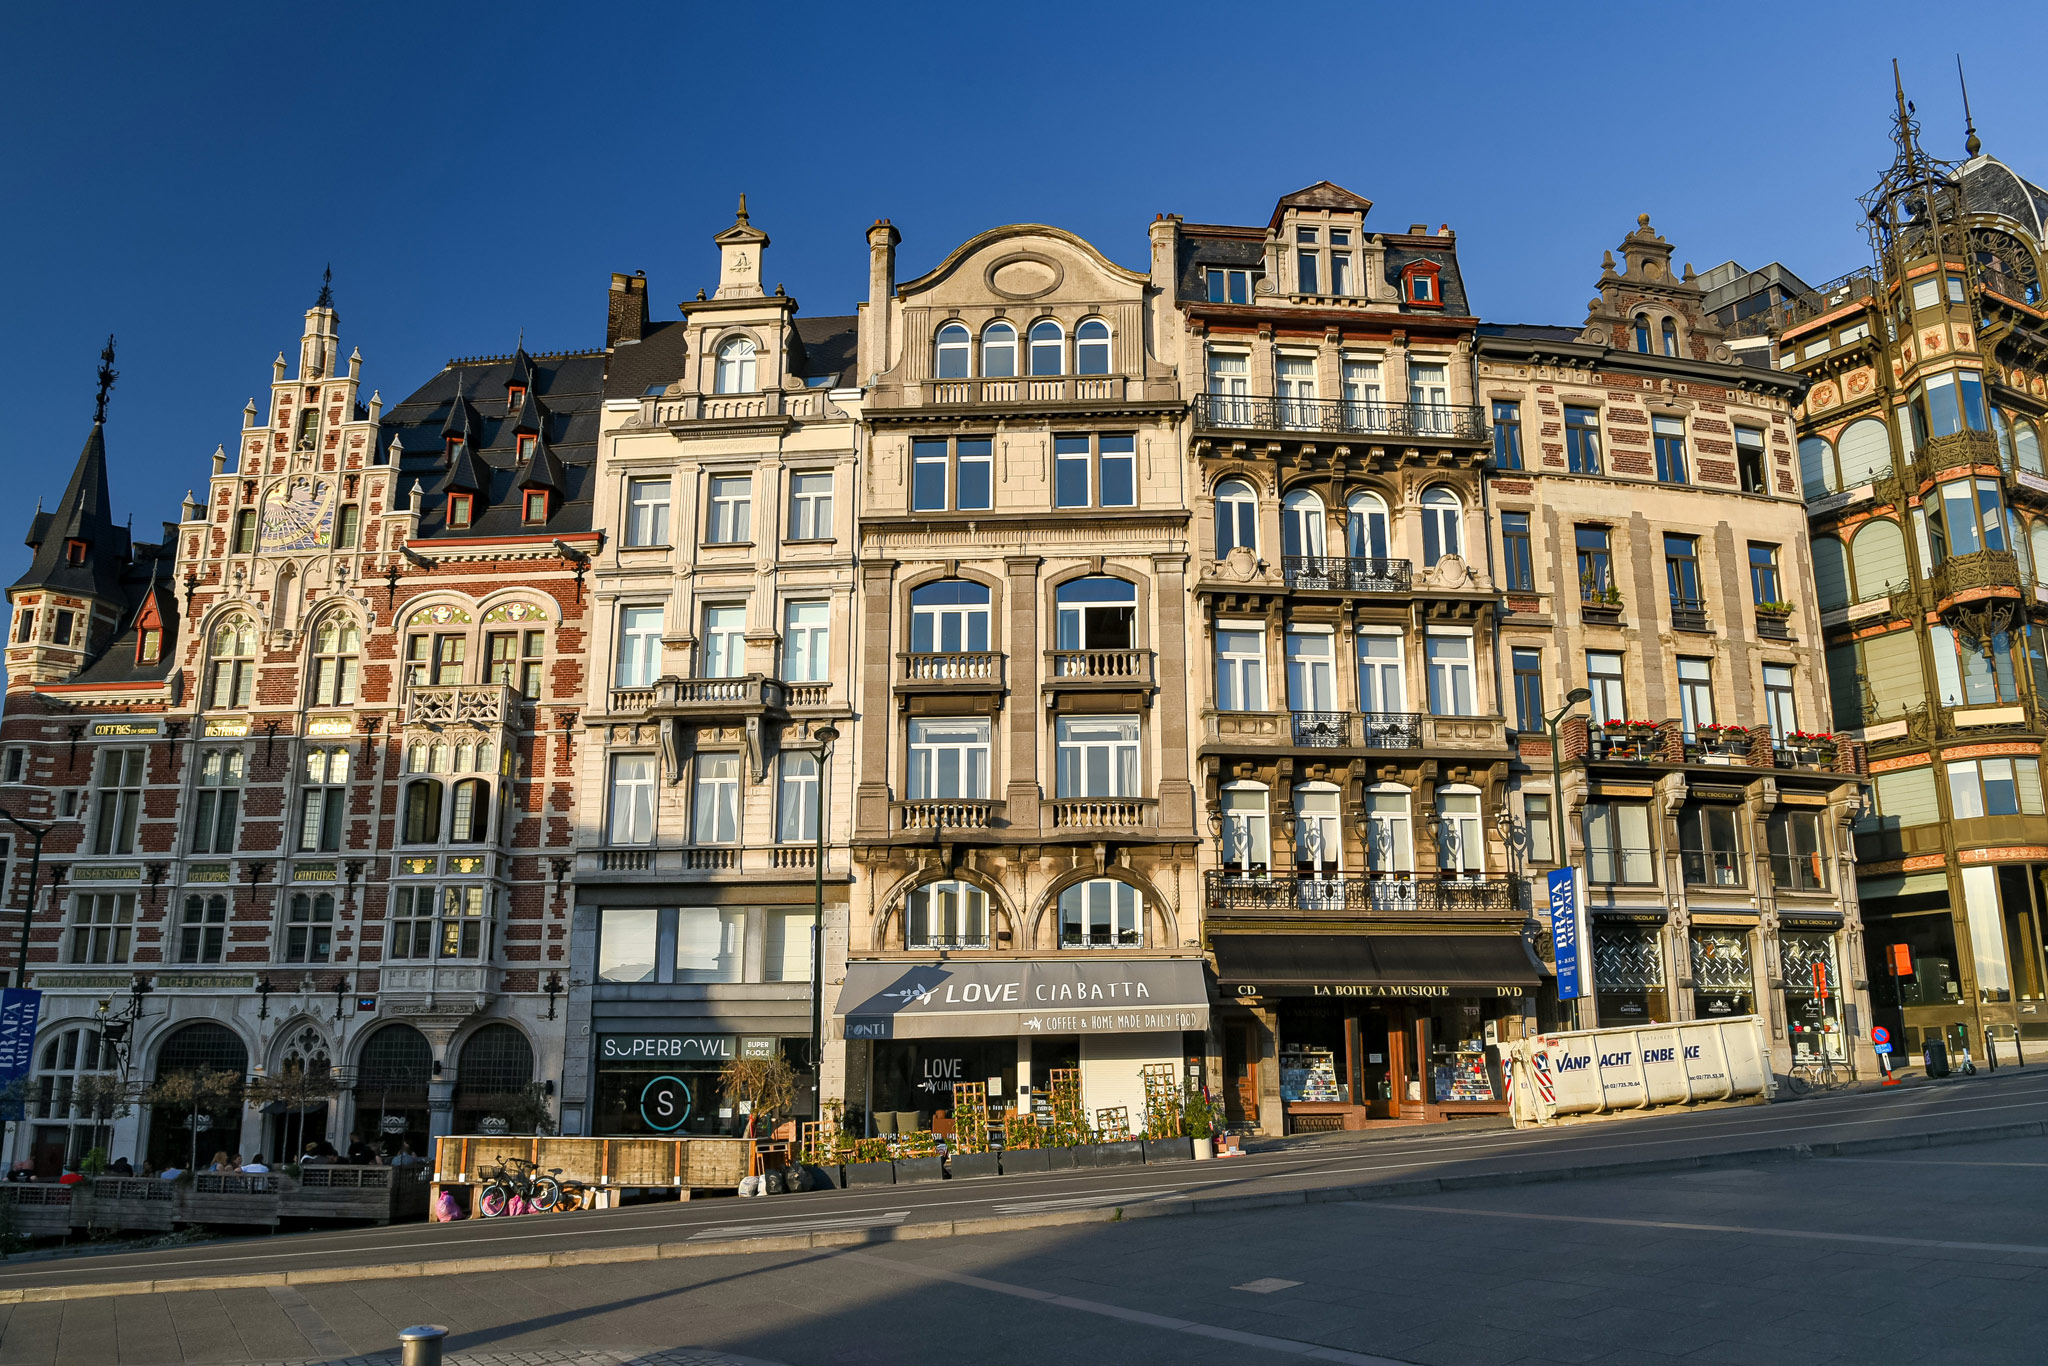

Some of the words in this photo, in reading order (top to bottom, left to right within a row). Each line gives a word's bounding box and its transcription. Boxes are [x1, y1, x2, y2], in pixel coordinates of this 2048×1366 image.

[1563, 879, 1573, 914] FAIR
[1551, 879, 1567, 949] BRAFA
[1566, 916, 1575, 946] ART
[945, 982, 1020, 1004] LOVE
[1035, 981, 1150, 1002] CIABATTA
[1237, 985, 1256, 995] CD
[1313, 985, 1331, 996] LA
[1335, 985, 1373, 996] BOITE
[1377, 986, 1387, 996] A
[1390, 985, 1450, 997] MUSIQUE
[1496, 986, 1523, 997] DVD
[19, 1003, 36, 1037] FAIR
[1046, 1017, 1078, 1031] COFFEE
[1081, 1020, 1087, 1029] &
[1091, 1016, 1113, 1030] HOME
[1117, 1015, 1141, 1029] MADE
[1145, 1014, 1172, 1028] DAILY
[1175, 1012, 1197, 1027] FOOD
[0, 1002, 21, 1068] BRAFA
[16, 1038, 29, 1067] ART
[924, 1058, 962, 1078] LOVE
[657, 1090, 674, 1116] S
